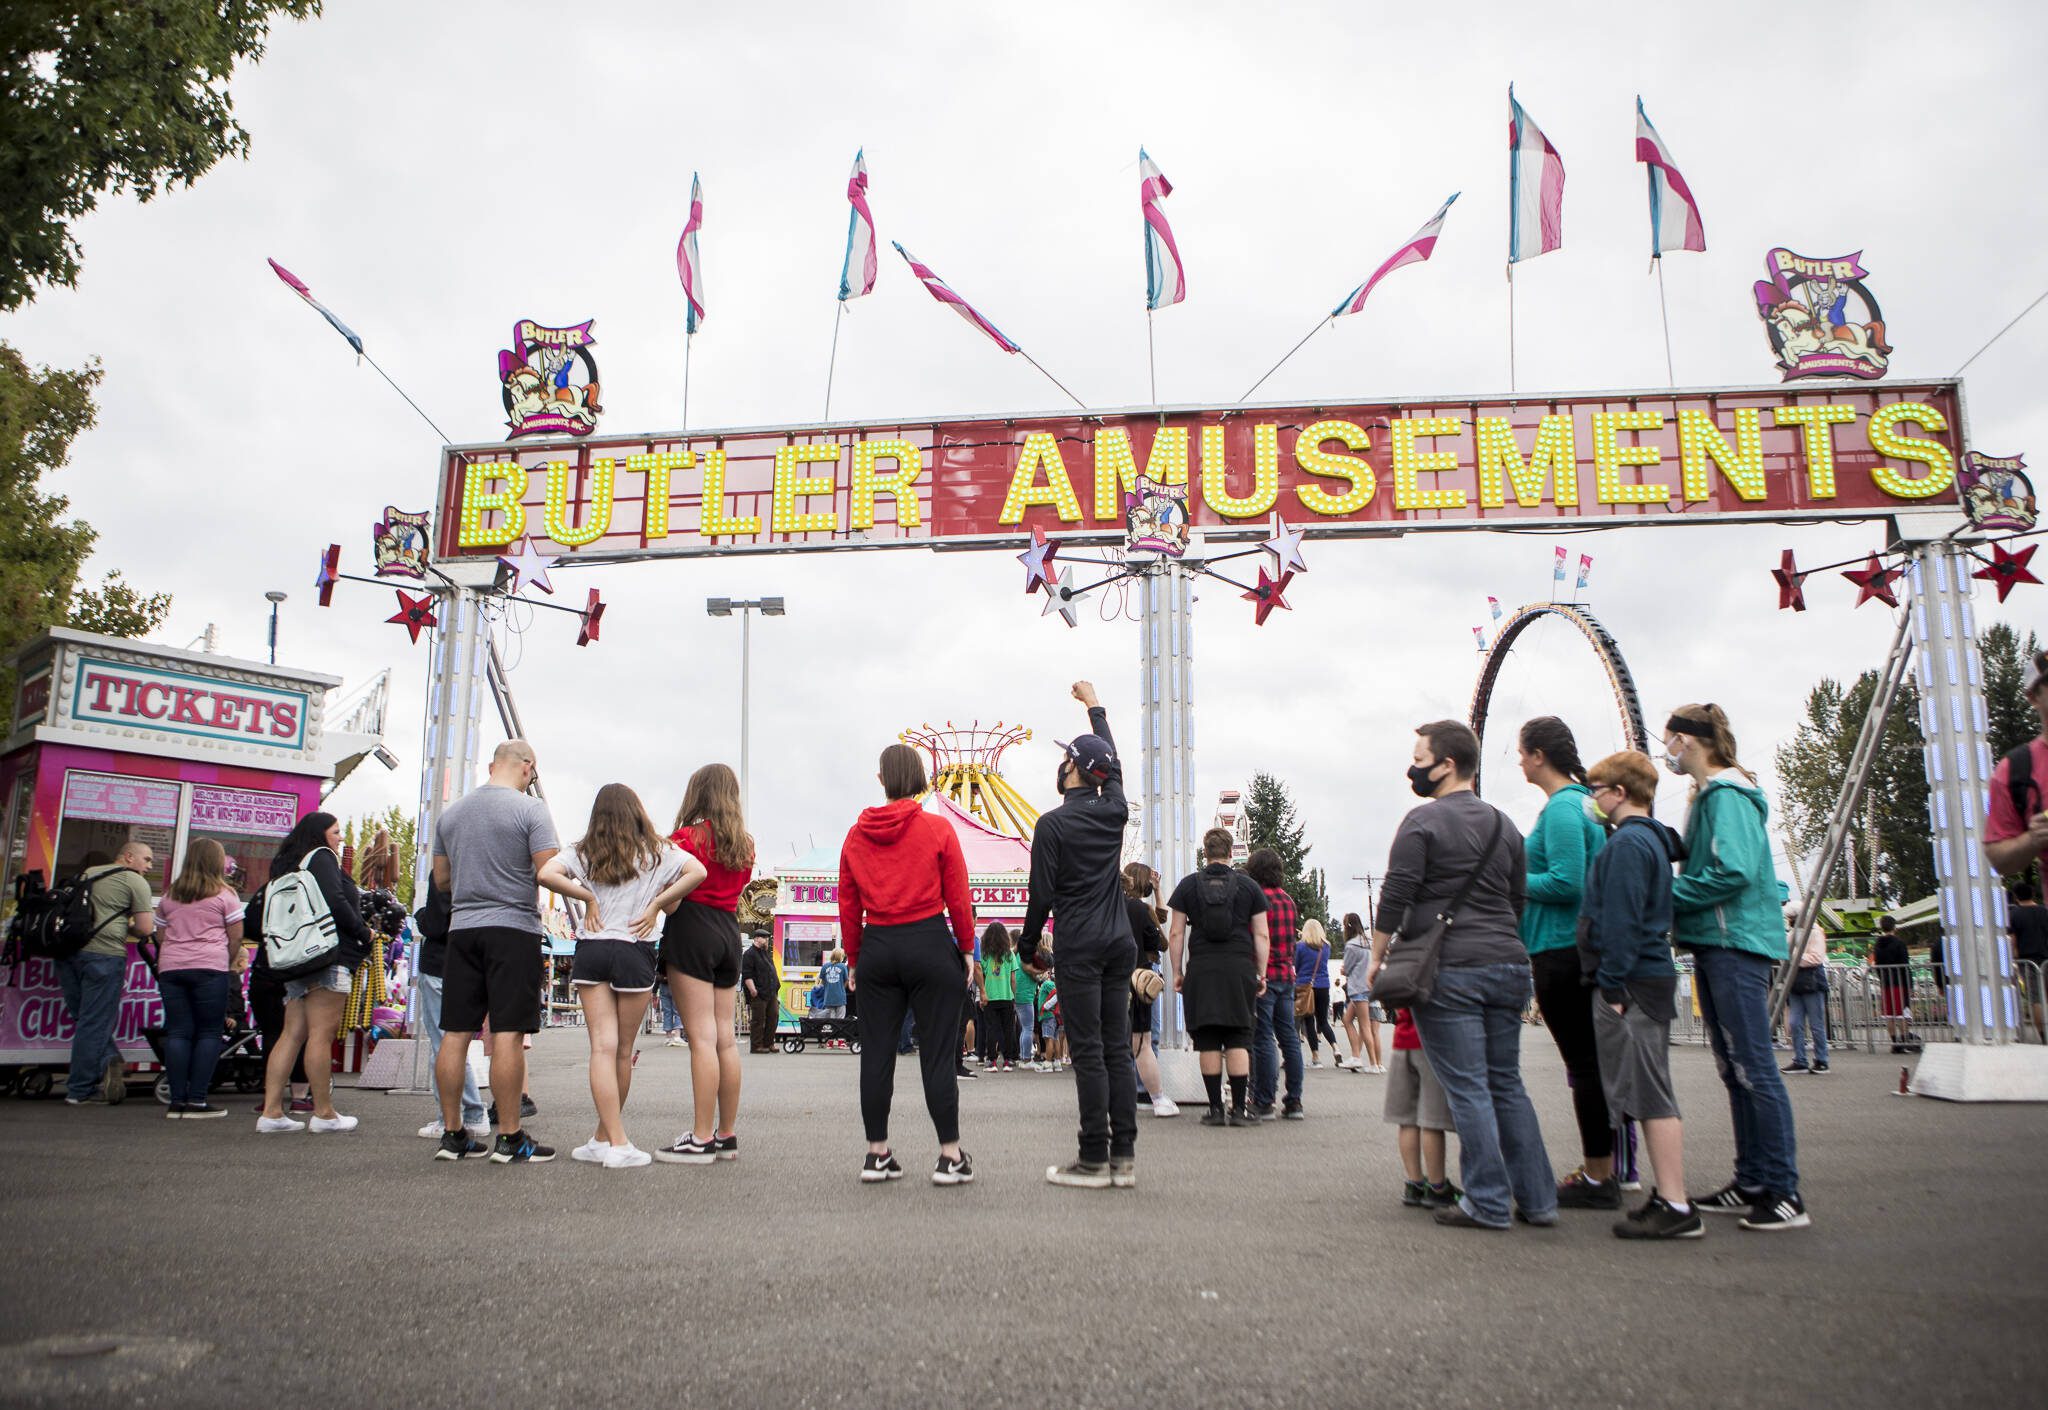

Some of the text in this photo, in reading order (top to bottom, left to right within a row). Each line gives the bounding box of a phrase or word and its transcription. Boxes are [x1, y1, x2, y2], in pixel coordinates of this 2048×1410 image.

[1774, 250, 1856, 279] BUTLER
[521, 321, 583, 345] BUTLER
[458, 401, 1954, 548] BUTLER AMUSEMENTS
[1140, 476, 1180, 498] BUTLER
[86, 672, 297, 738] TICKETS
